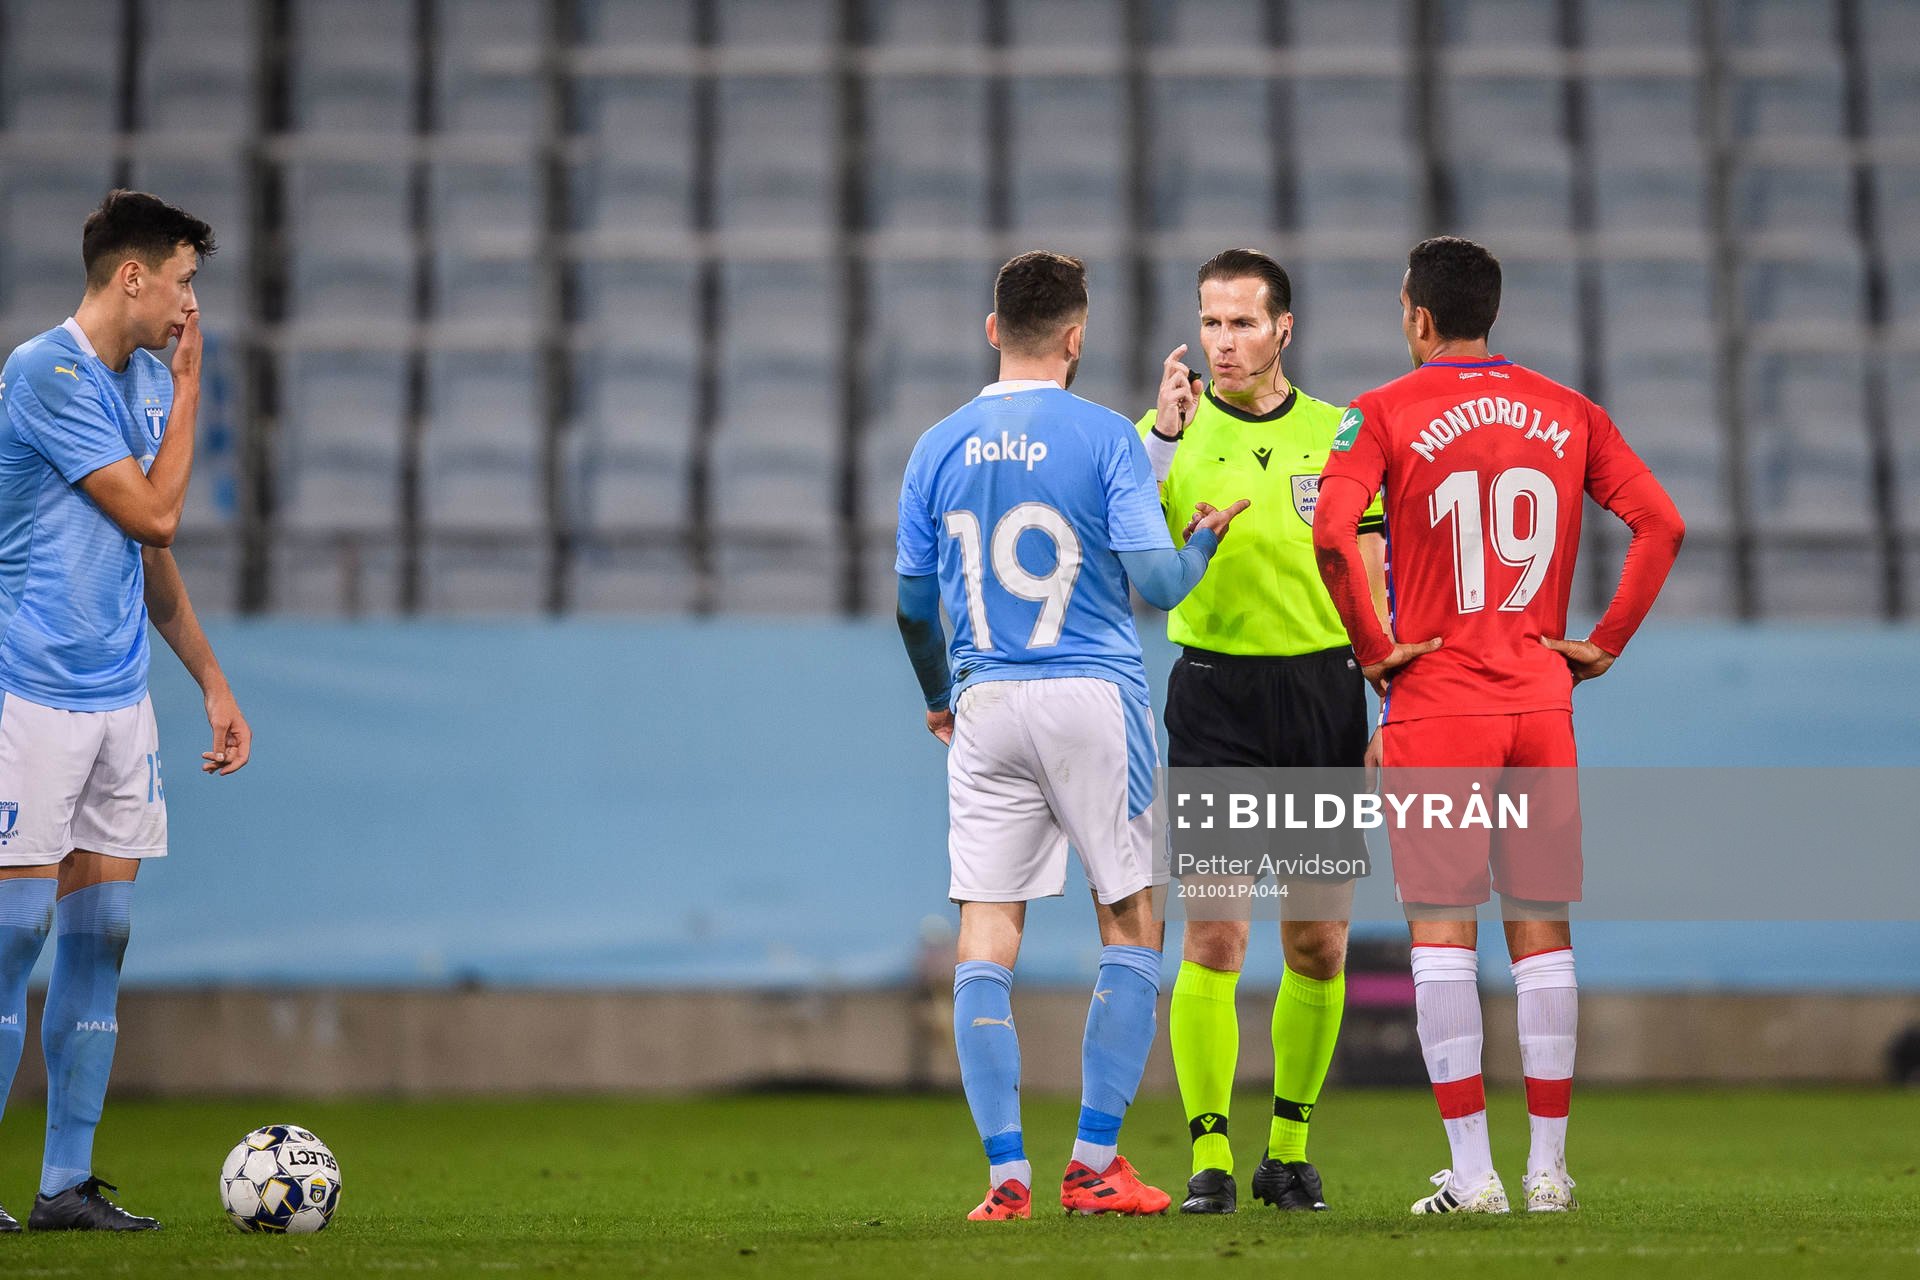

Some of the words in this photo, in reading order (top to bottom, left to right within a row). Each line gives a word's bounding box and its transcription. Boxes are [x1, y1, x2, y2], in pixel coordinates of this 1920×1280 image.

[1409, 396, 1528, 463] MONTORO
[965, 430, 1048, 472] Rakip
[1300, 481, 1318, 491] UEF
[1428, 467, 1558, 615] 19
[943, 501, 1083, 651] 19
[76, 1020, 119, 1034] MALM
[289, 1150, 337, 1171] SELECT
